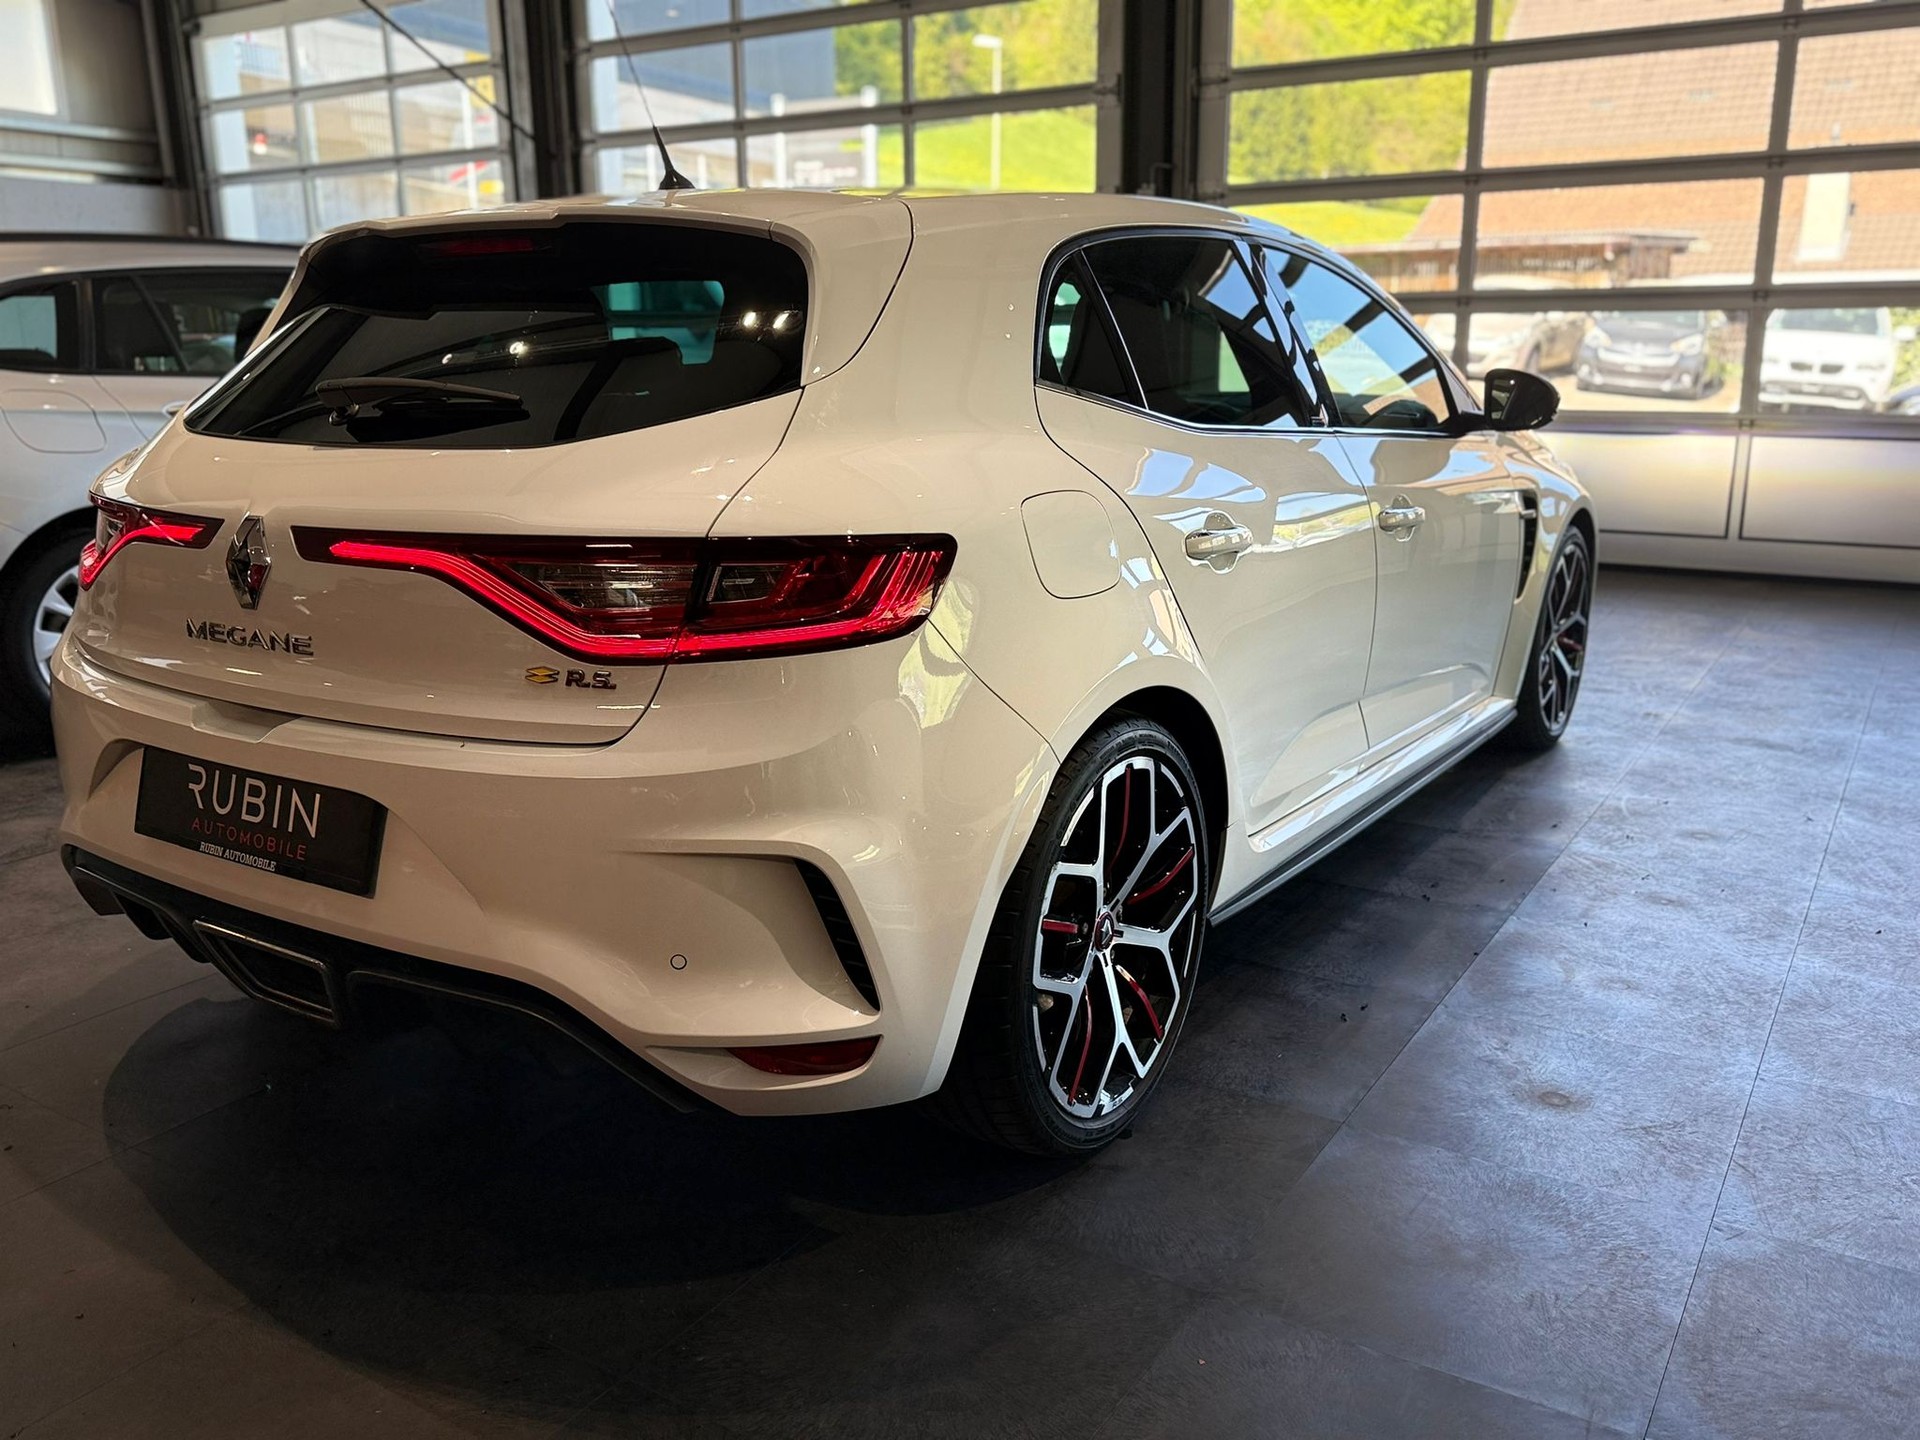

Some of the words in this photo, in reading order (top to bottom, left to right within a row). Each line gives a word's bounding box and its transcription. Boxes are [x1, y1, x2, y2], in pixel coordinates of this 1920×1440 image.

[186, 618, 314, 656] MEGANE
[188, 763, 321, 838] RUBIN
[191, 817, 307, 861] AUTOMOBILE
[199, 841, 223, 857] RUBIN
[223, 849, 277, 872] AUTOMOBILE
